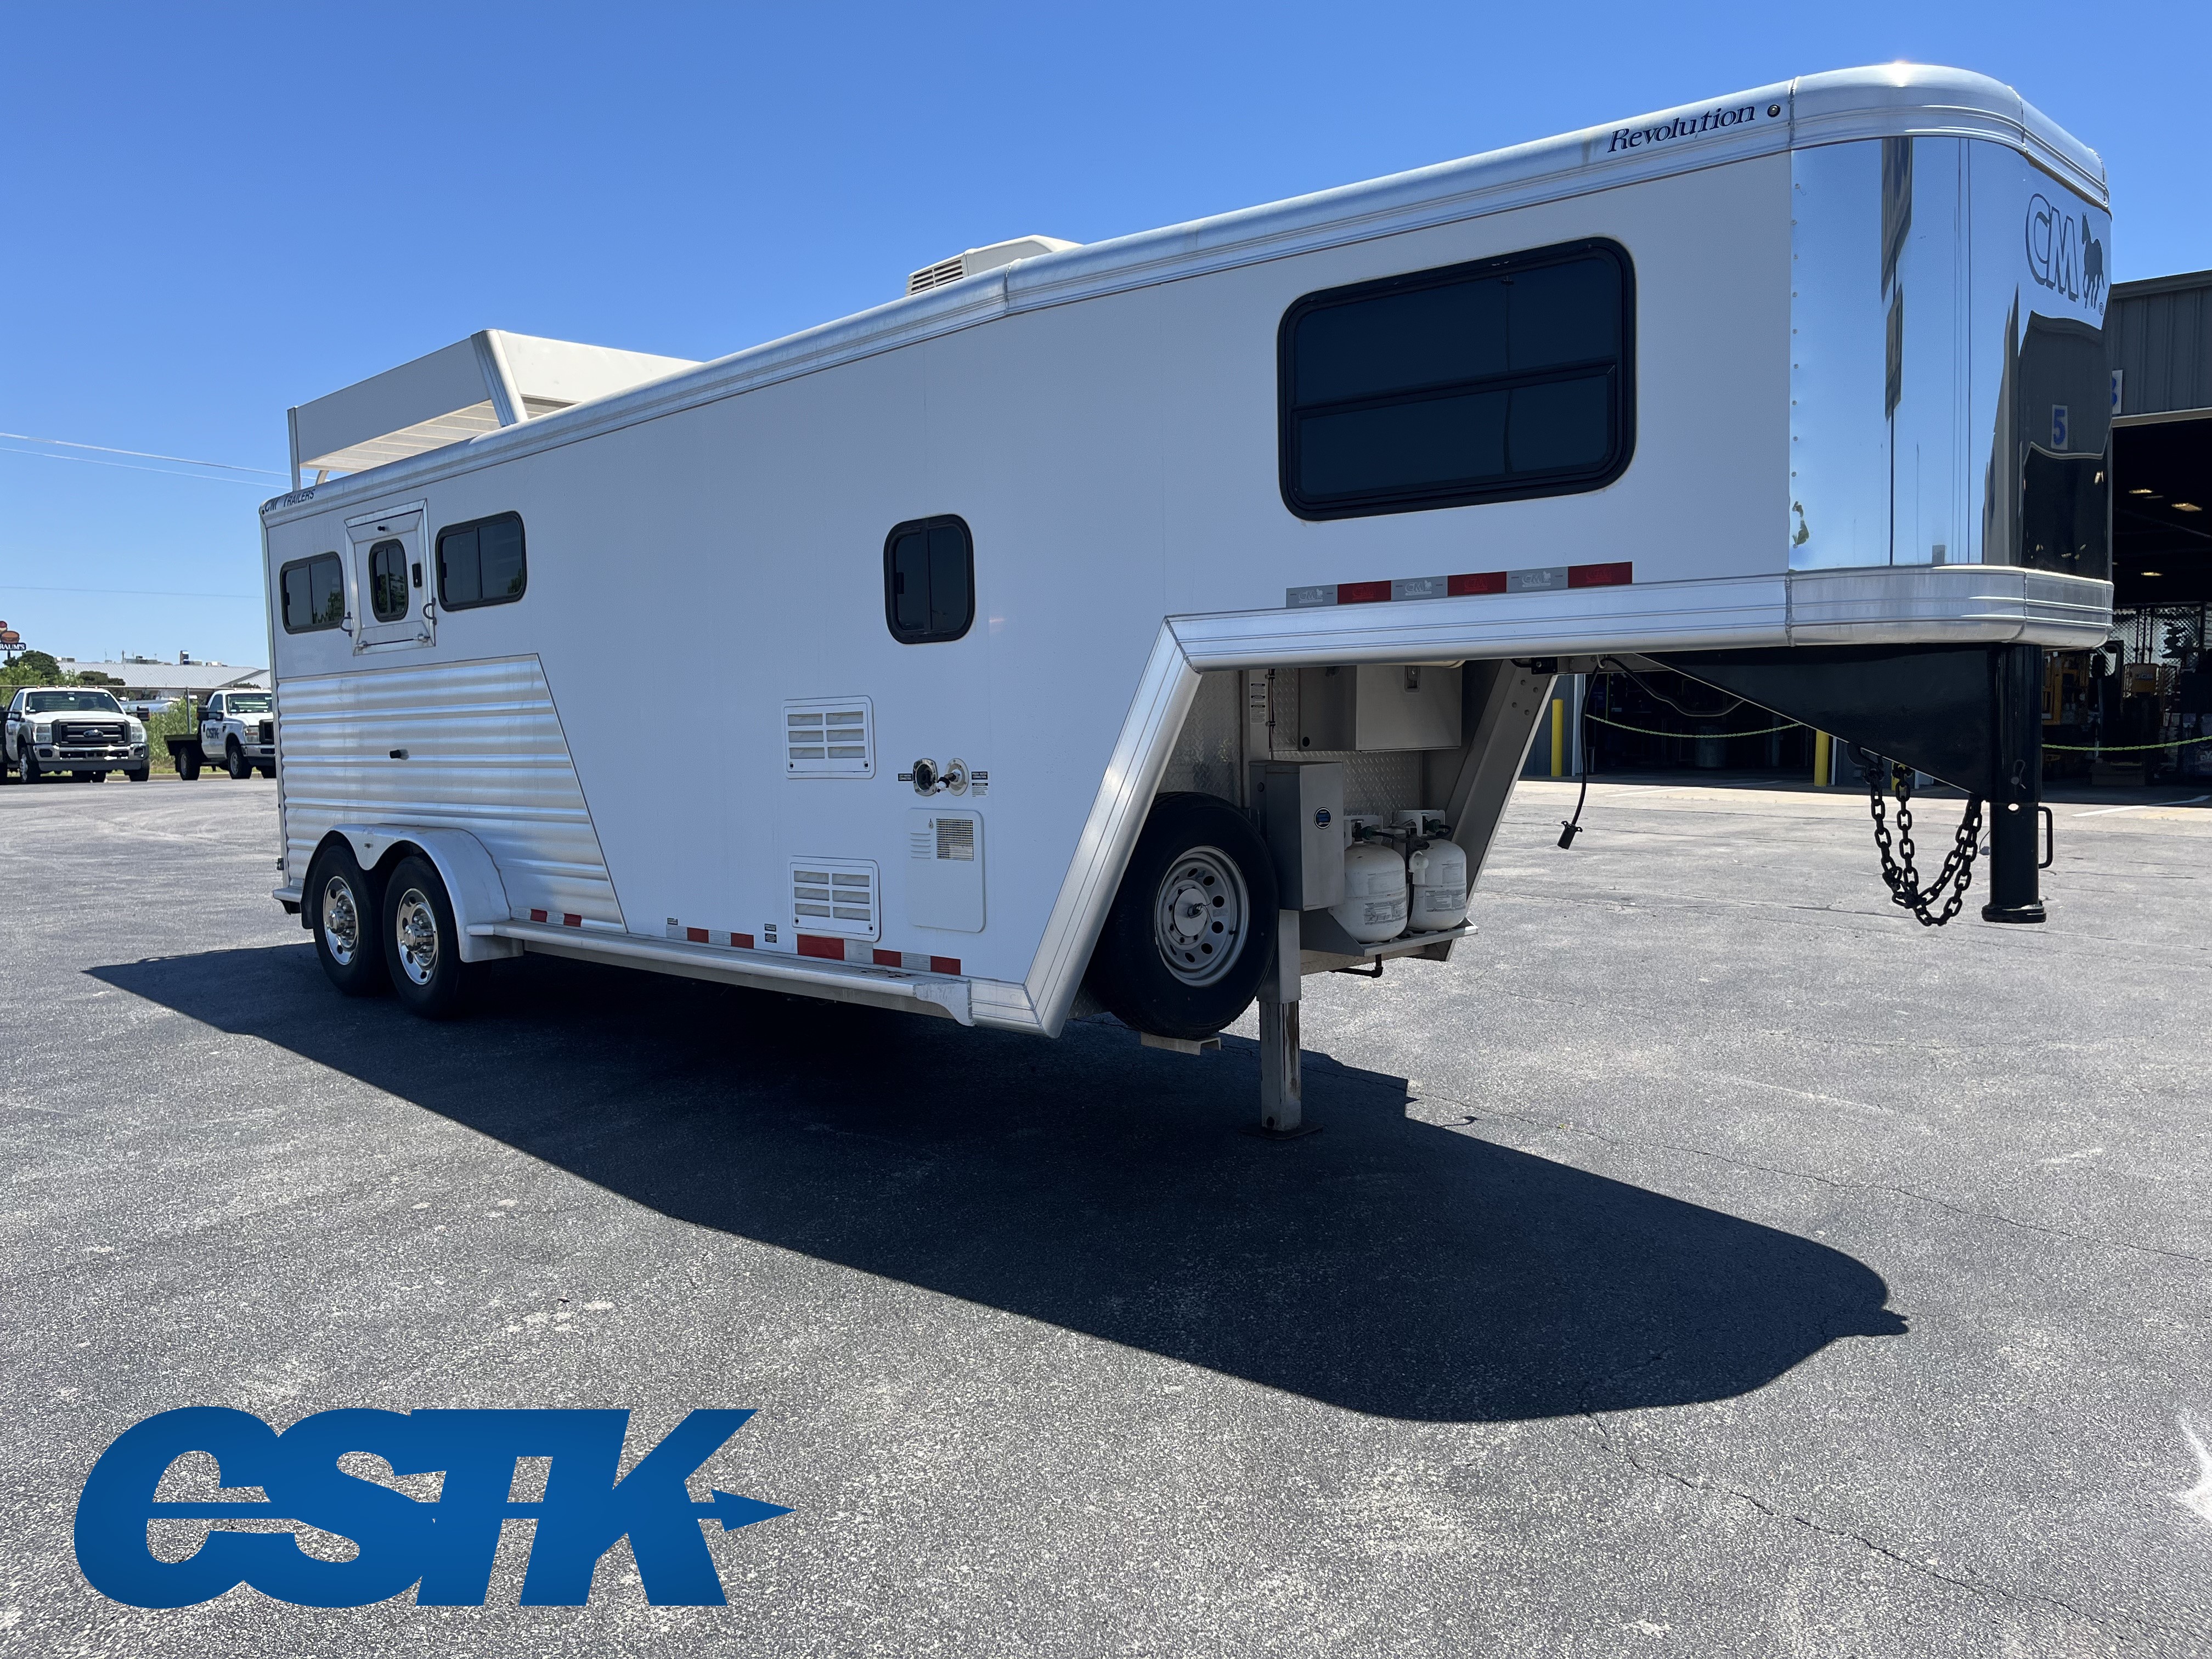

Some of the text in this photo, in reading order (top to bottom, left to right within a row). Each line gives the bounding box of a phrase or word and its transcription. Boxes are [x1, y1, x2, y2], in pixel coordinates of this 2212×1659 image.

[1607, 105, 1755, 153] Revolution
[2025, 193, 2079, 302] CM
[264, 489, 316, 512] CM TRAILERS
